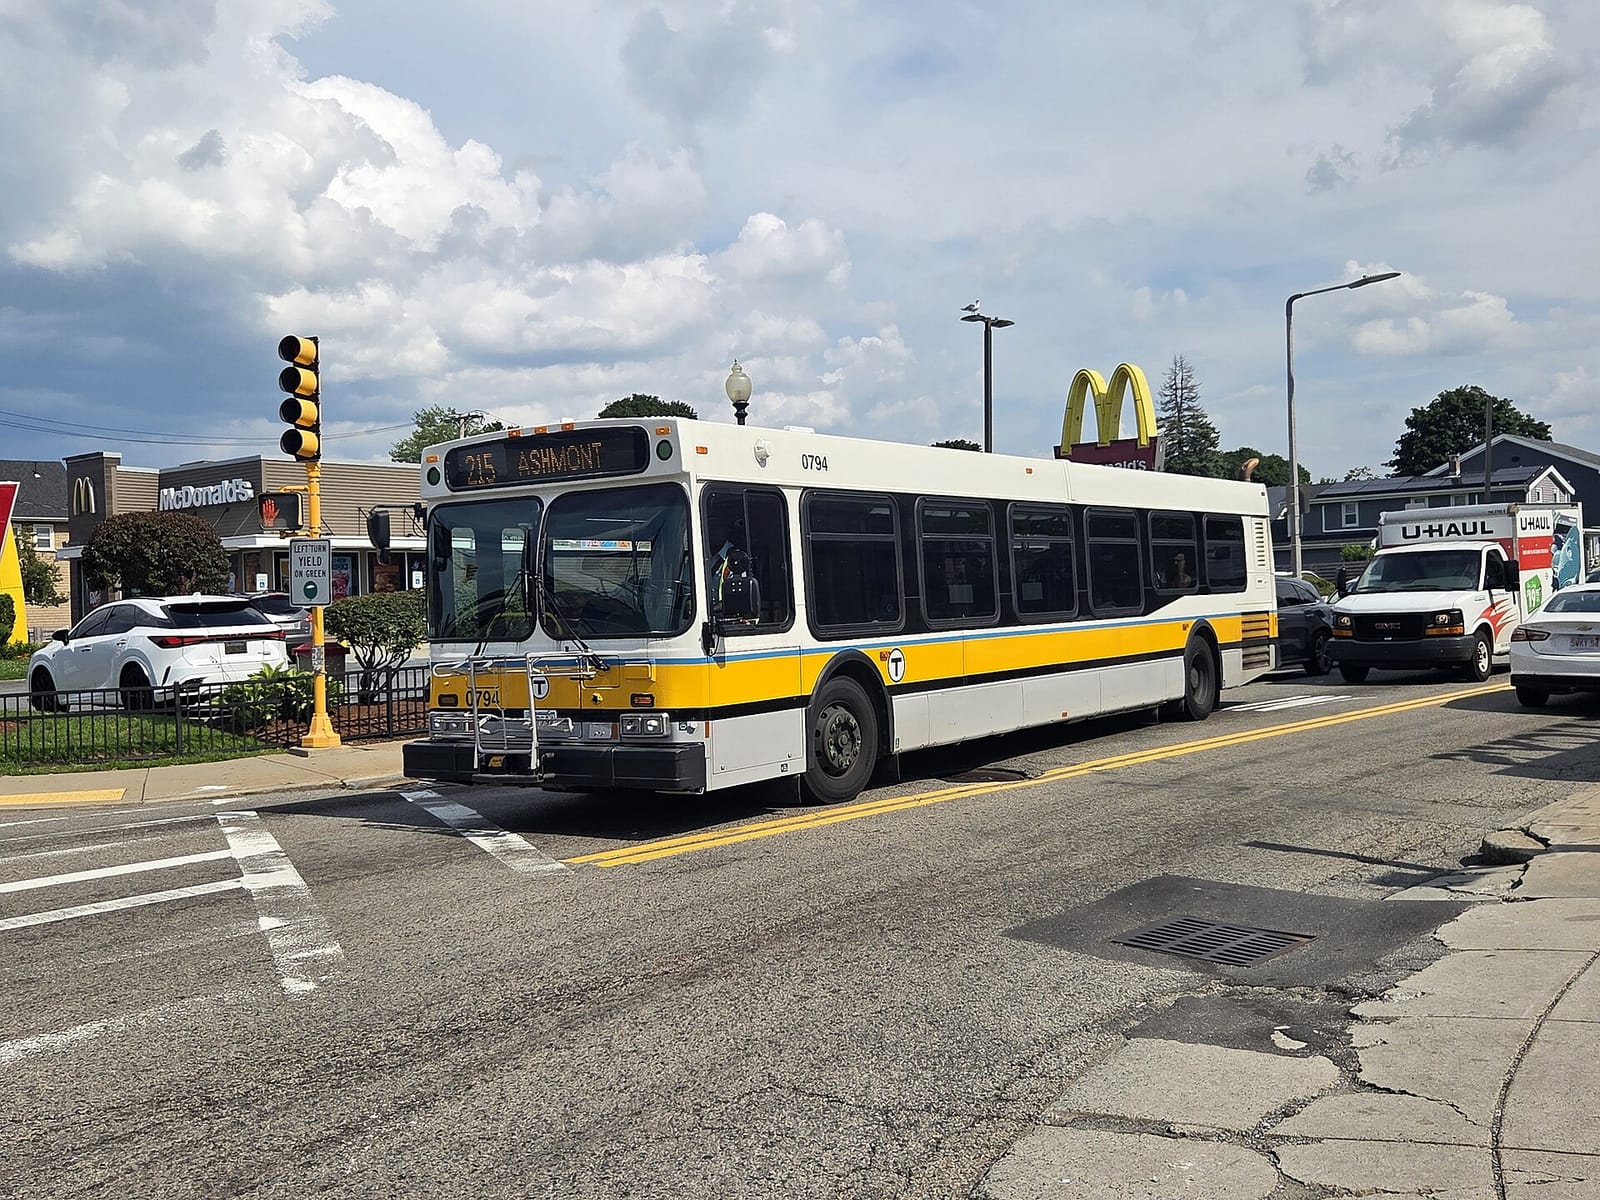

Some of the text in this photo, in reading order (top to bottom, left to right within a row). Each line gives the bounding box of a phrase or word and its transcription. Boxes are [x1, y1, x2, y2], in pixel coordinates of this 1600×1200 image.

[465, 442, 602, 485] 215 ASHMONT
[802, 454, 828, 471] 0794
[159, 478, 255, 511] McDonald's
[1402, 520, 1494, 540] U-HAUL
[1520, 515, 1551, 531] U-HAUL
[294, 544, 327, 553] LEFT TURN
[299, 556, 322, 567] YIELD
[294, 569, 327, 578] ON GREEN
[891, 657, 902, 677] T
[533, 679, 546, 696] T
[466, 690, 499, 707] 0794
